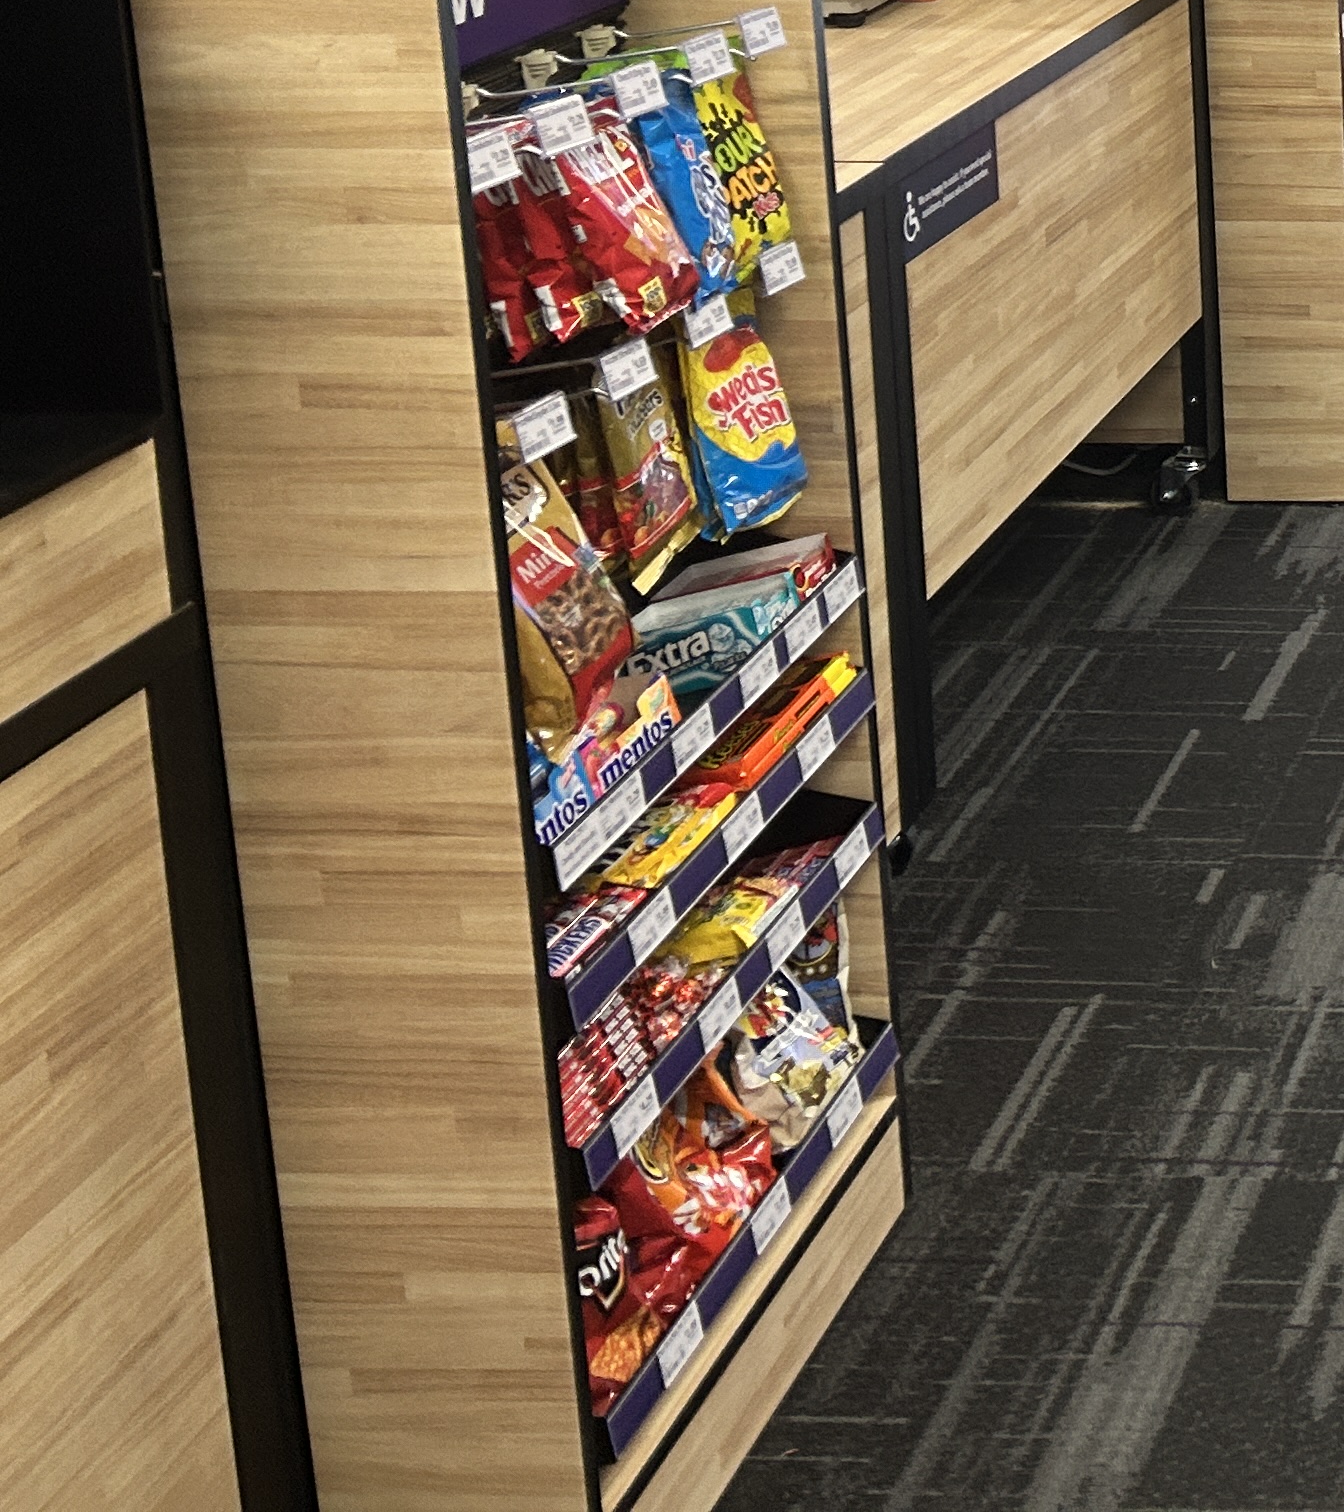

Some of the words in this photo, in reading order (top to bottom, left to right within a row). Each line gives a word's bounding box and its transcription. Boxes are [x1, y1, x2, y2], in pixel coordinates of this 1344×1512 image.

[714, 125, 763, 174] OUR
[732, 396, 792, 441] Fish
[625, 630, 710, 677] Extra
[599, 710, 673, 789] mentos
[535, 789, 588, 845] ntos
